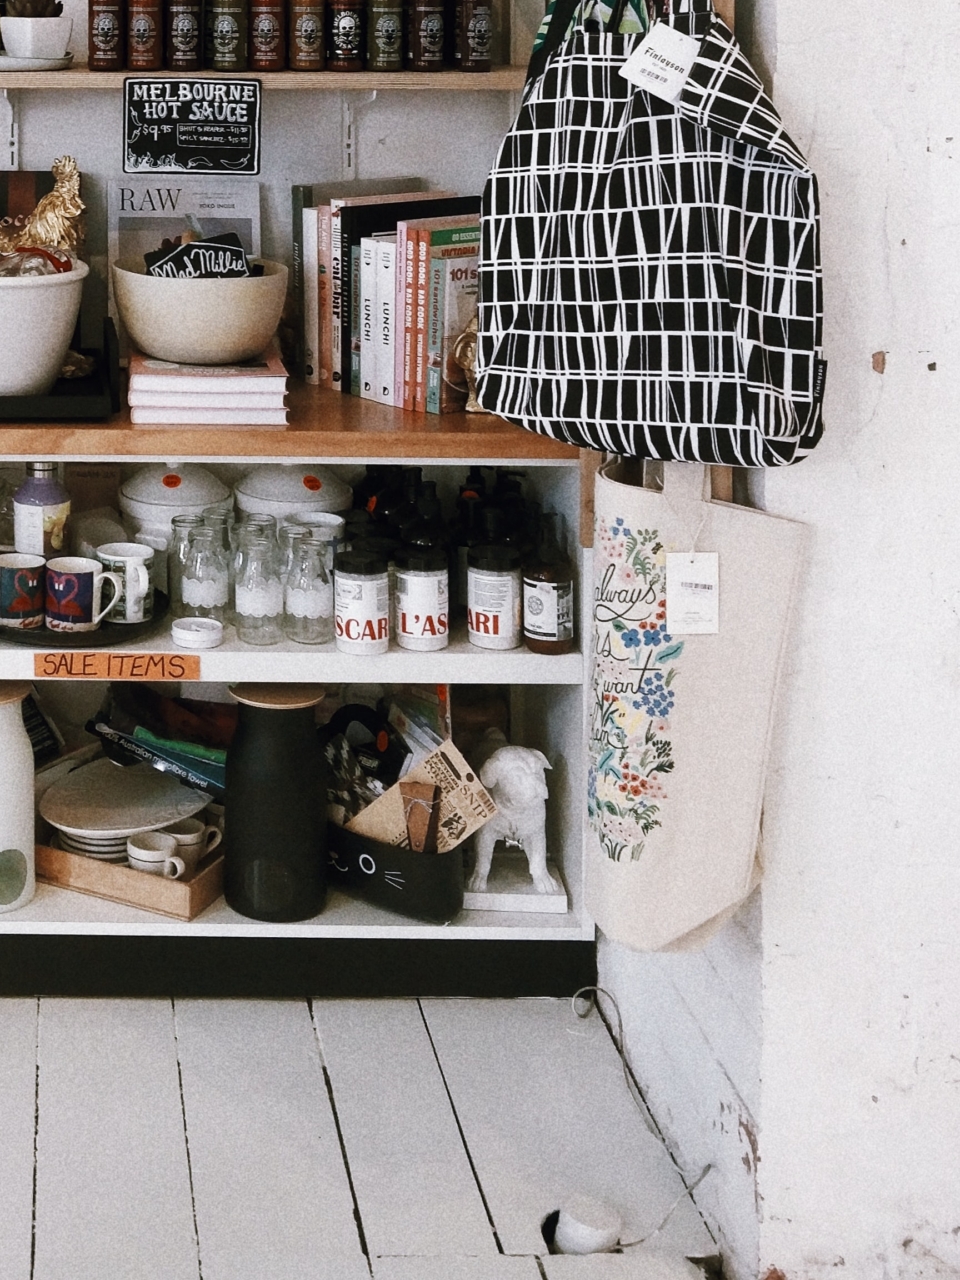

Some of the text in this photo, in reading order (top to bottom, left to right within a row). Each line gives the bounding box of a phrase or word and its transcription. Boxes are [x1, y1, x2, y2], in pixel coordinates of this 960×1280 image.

[644, 47, 686, 74] Finlayson
[132, 83, 255, 102] MELBOURNE
[143, 102, 248, 122] HOT SAUCE
[142, 123, 174, 141] $9.95
[118, 187, 183, 211] RAW
[406, 240, 414, 260] GOOD
[418, 241, 426, 261] GOOD
[151, 247, 246, 278] Mad Millie
[450, 269, 469, 281] 101
[405, 288, 413, 304] BAD
[417, 290, 425, 305] BAD
[431, 269, 441, 346] 101 sandwiches
[405, 306, 413, 329] COOK
[417, 306, 425, 330] COOK
[595, 563, 656, 622] always
[43, 653, 186, 677] SALE ITEMS
[604, 649, 662, 696] want
[119, 737, 153, 764] Australian
[152, 752, 188, 778] microfibre
[187, 767, 209, 790] towel
[424, 759, 453, 797] POUCH
[459, 783, 489, 821] SNIP
